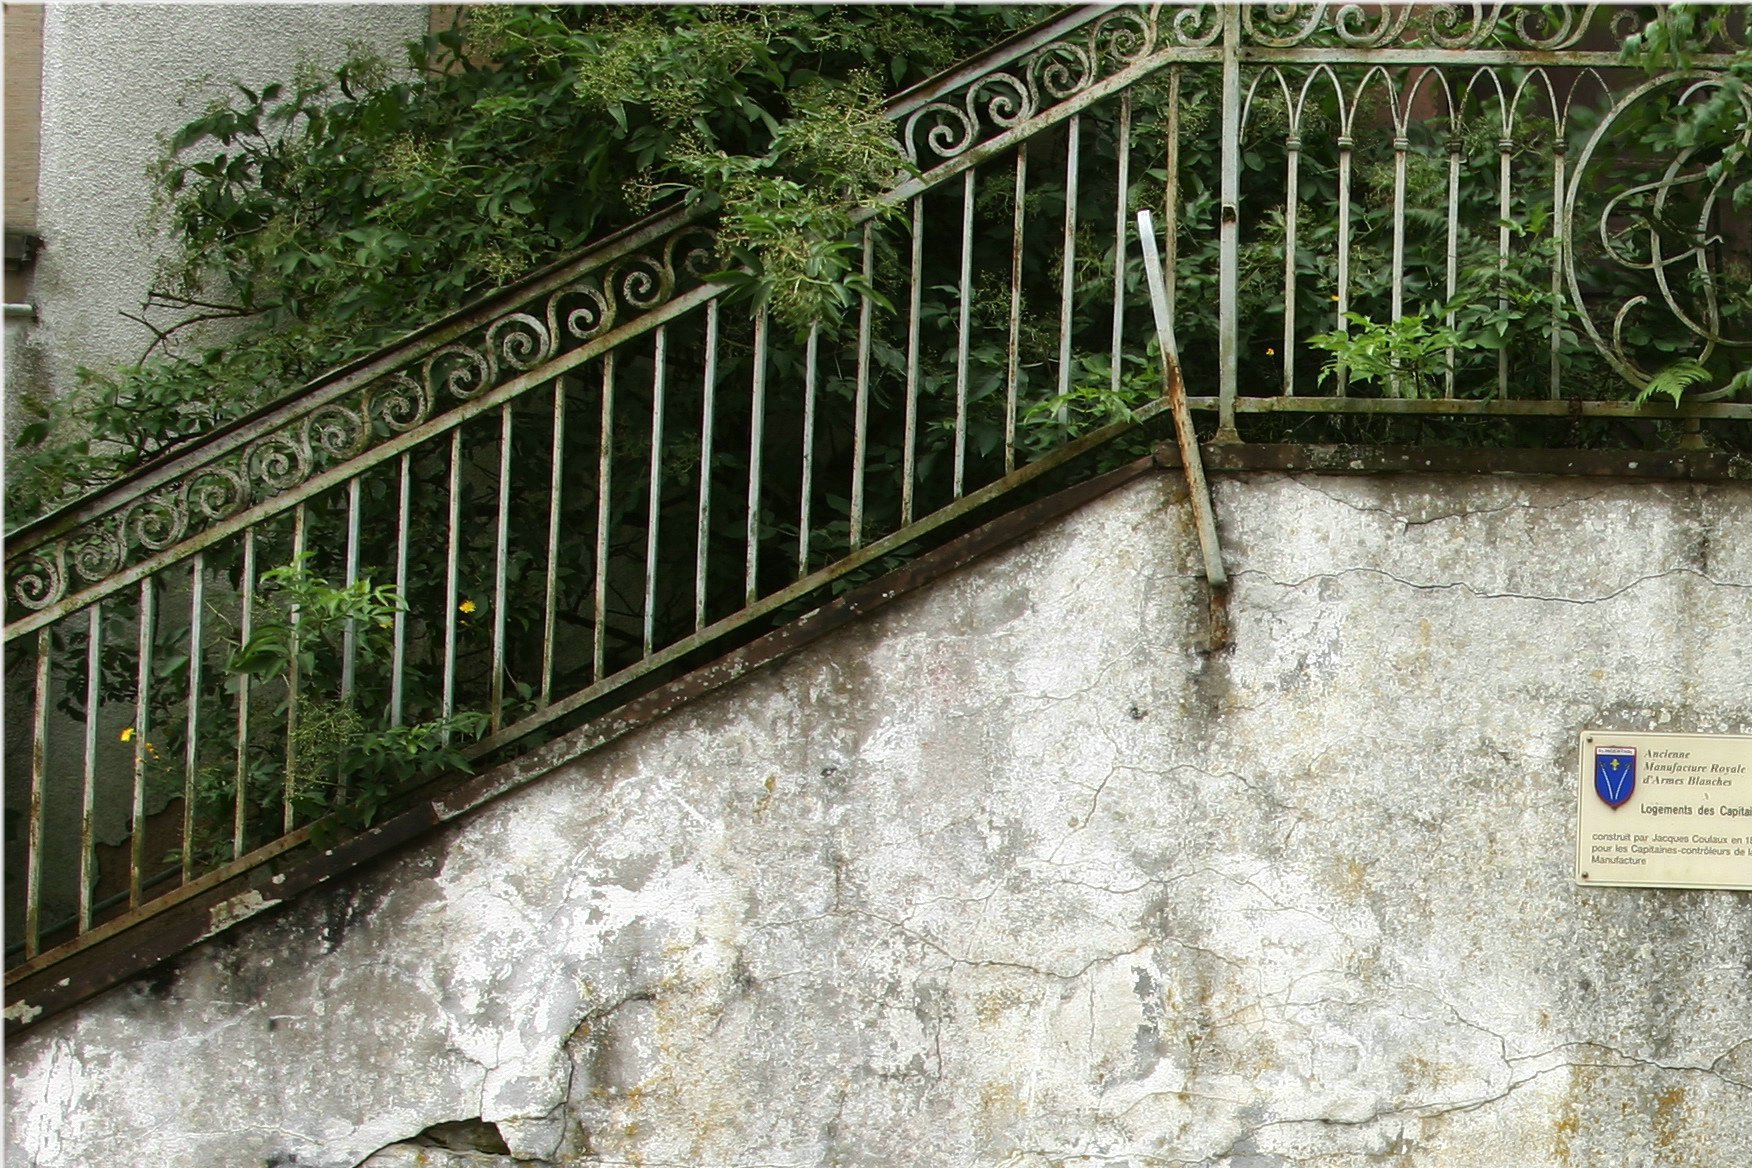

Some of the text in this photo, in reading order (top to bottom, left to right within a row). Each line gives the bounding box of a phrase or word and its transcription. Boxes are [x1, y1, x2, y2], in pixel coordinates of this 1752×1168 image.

[1644, 748, 1691, 759] Ancienne
[1643, 762, 1747, 775] Manufacture Royale
[1643, 775, 1732, 787] d'Armes Blanches
[1641, 803, 1693, 816] Logements
[1698, 805, 1715, 816] des
[1592, 833, 1631, 841] construit
[1633, 834, 1649, 843] par
[1652, 834, 1689, 844] Jacques
[1731, 837, 1743, 845] en
[1592, 844, 1612, 854] pour
[1615, 844, 1628, 853] les
[1734, 847, 1746, 856] de
[1592, 855, 1647, 865] Manufacture
